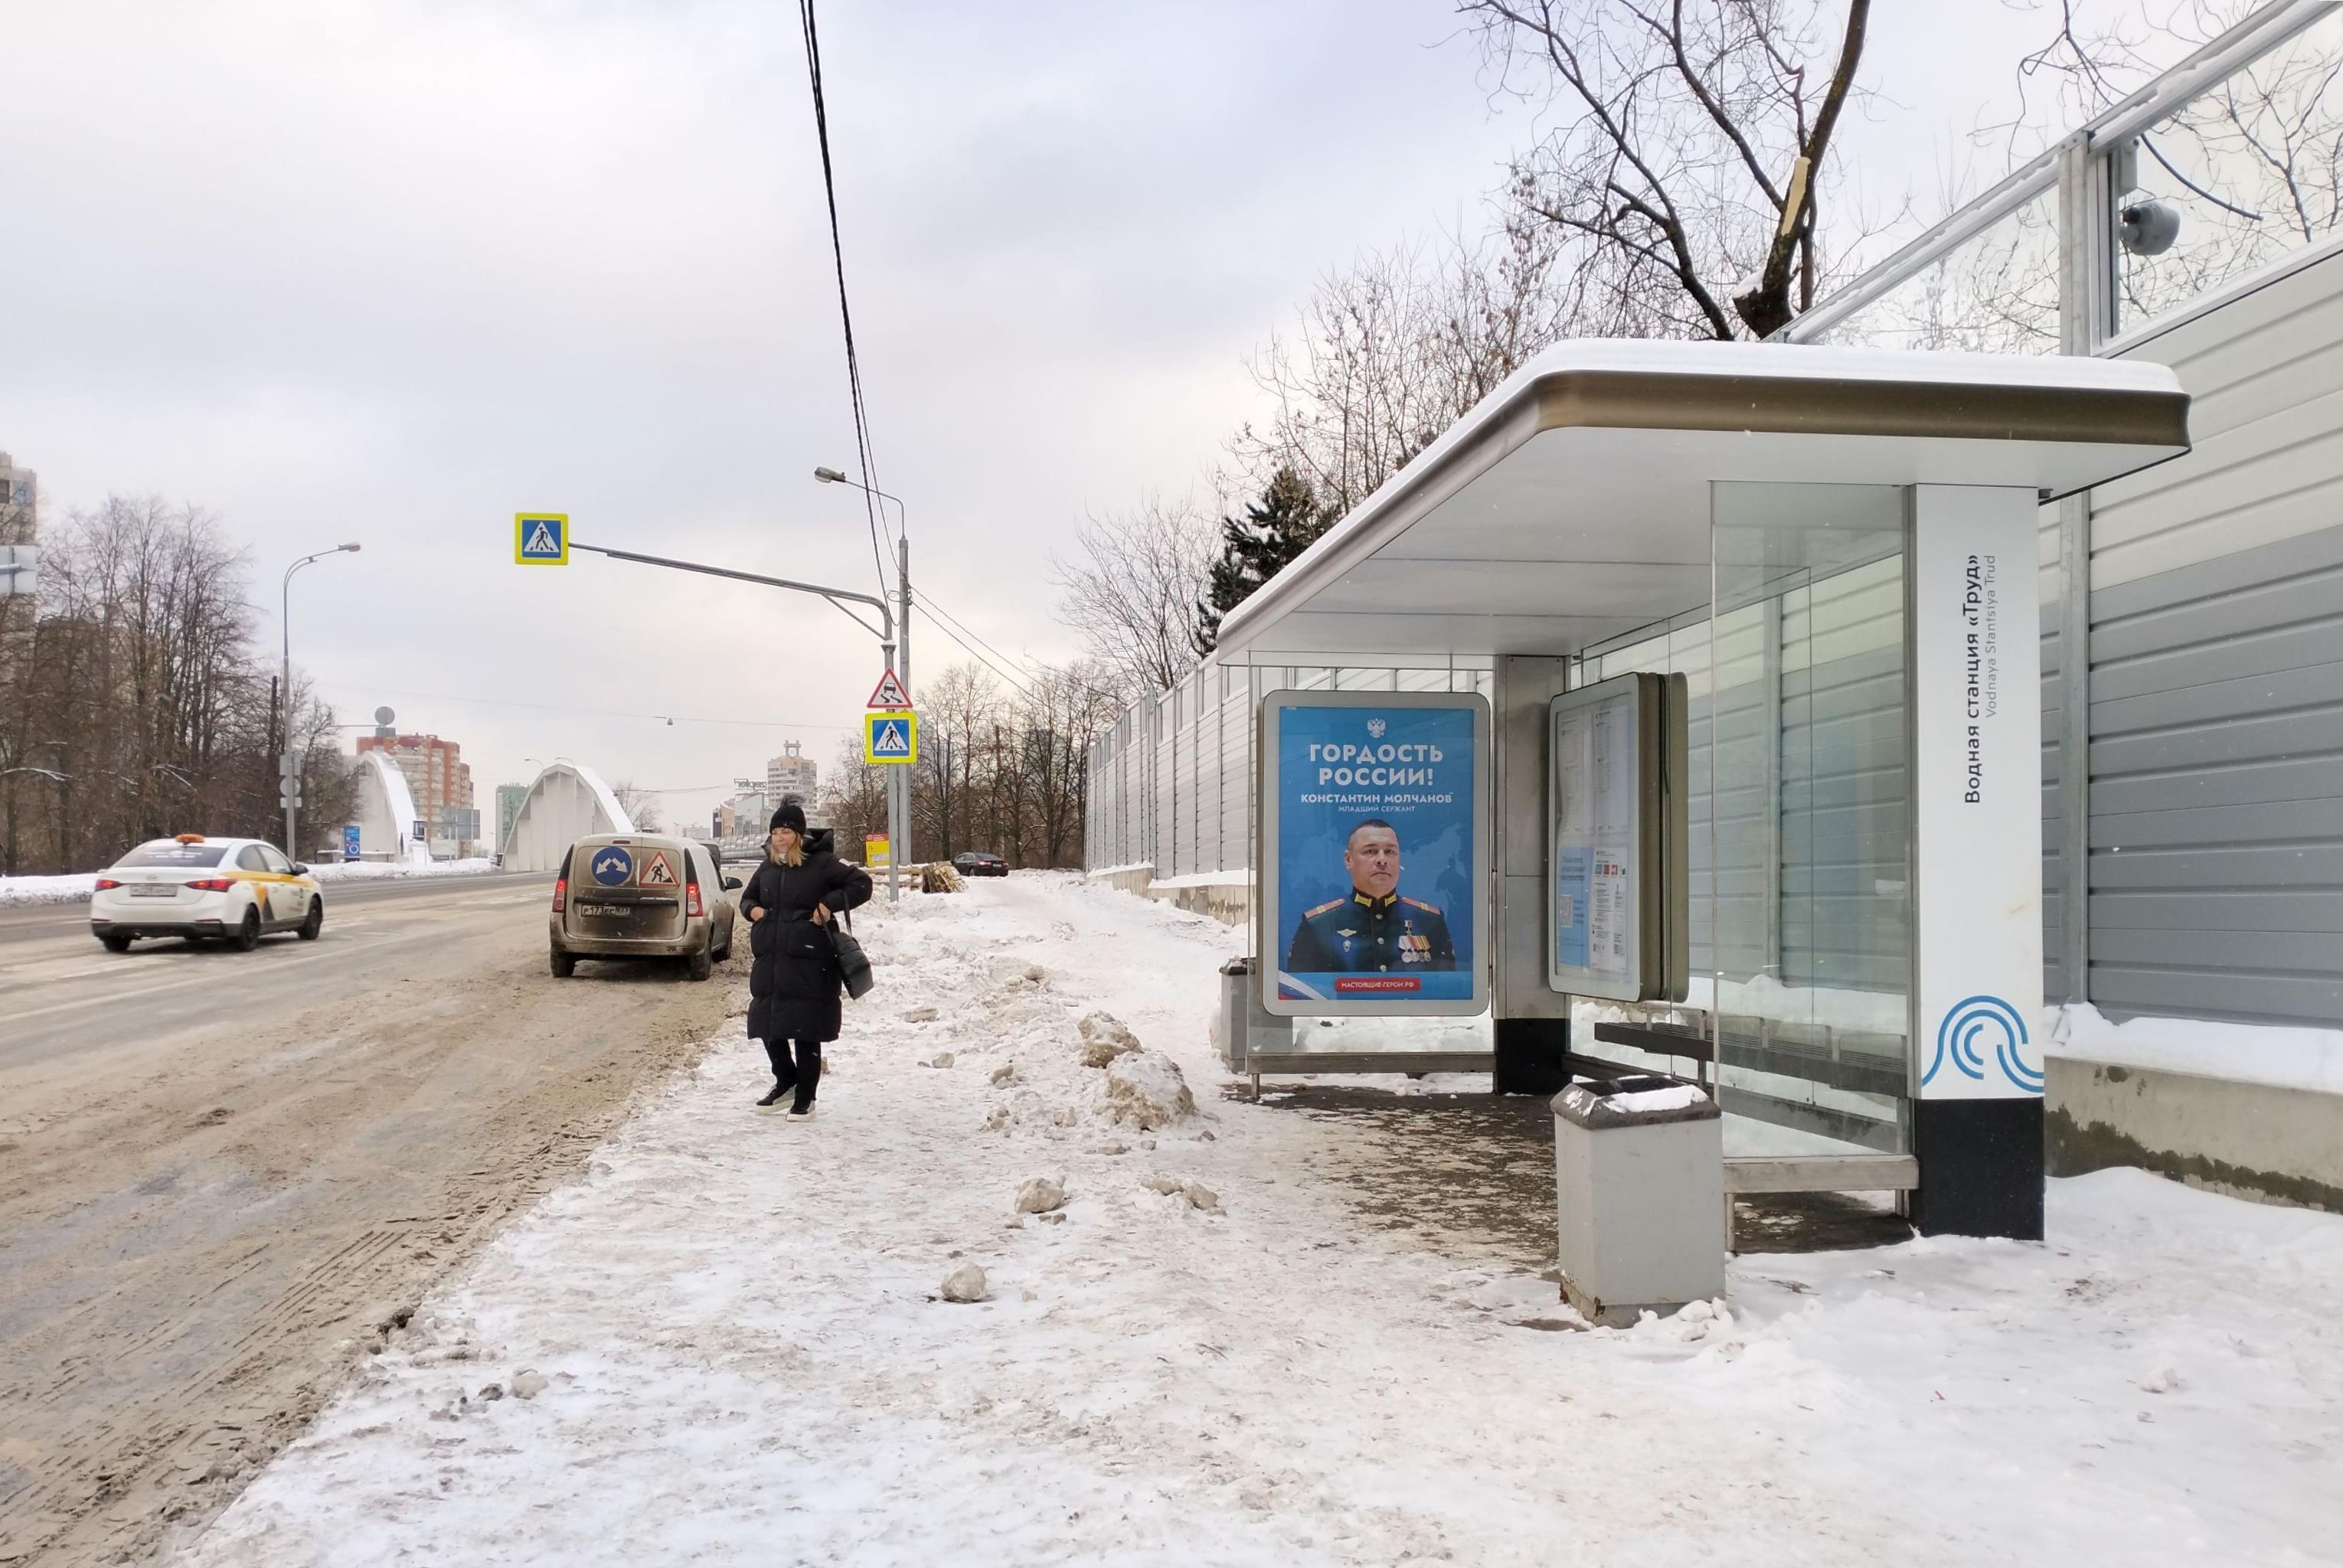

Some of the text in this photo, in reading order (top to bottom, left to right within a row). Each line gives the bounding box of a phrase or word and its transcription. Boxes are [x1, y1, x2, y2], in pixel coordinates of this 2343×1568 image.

[1984, 555, 1998, 717] Vodnaya Stantsiya Trud
[1962, 554, 1982, 803] Водная станция «Труд»
[1310, 744, 1443, 764] ГОРДОСТЬ
[1319, 767, 1433, 786] РОССИИ!
[1301, 794, 1452, 803] КОНСТАНТИН МОЛЧАНОВ
